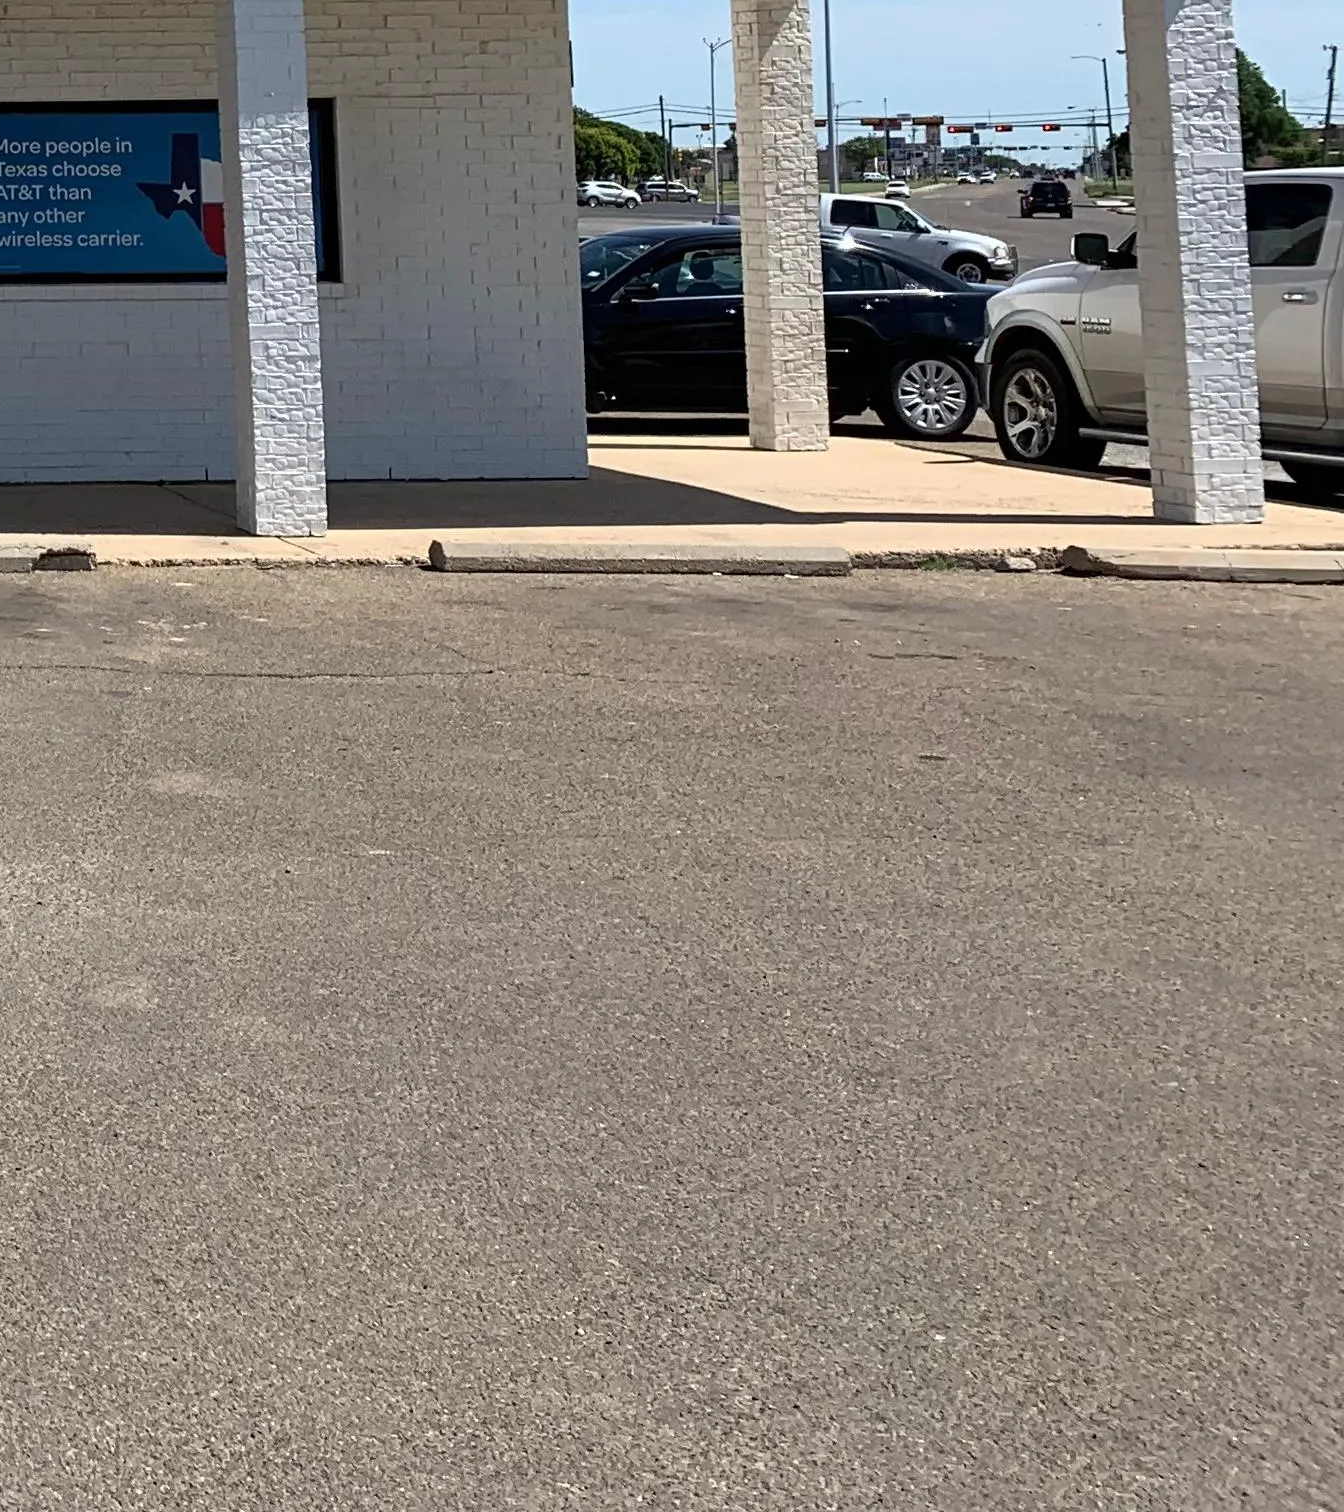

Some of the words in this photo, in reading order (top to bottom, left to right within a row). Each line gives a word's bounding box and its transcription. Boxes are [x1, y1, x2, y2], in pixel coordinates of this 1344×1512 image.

[45, 137, 112, 157] people
[116, 137, 133, 153] in
[52, 160, 122, 177] choose
[48, 184, 92, 200] than
[33, 208, 86, 224] other
[77, 229, 144, 247] carrier.
